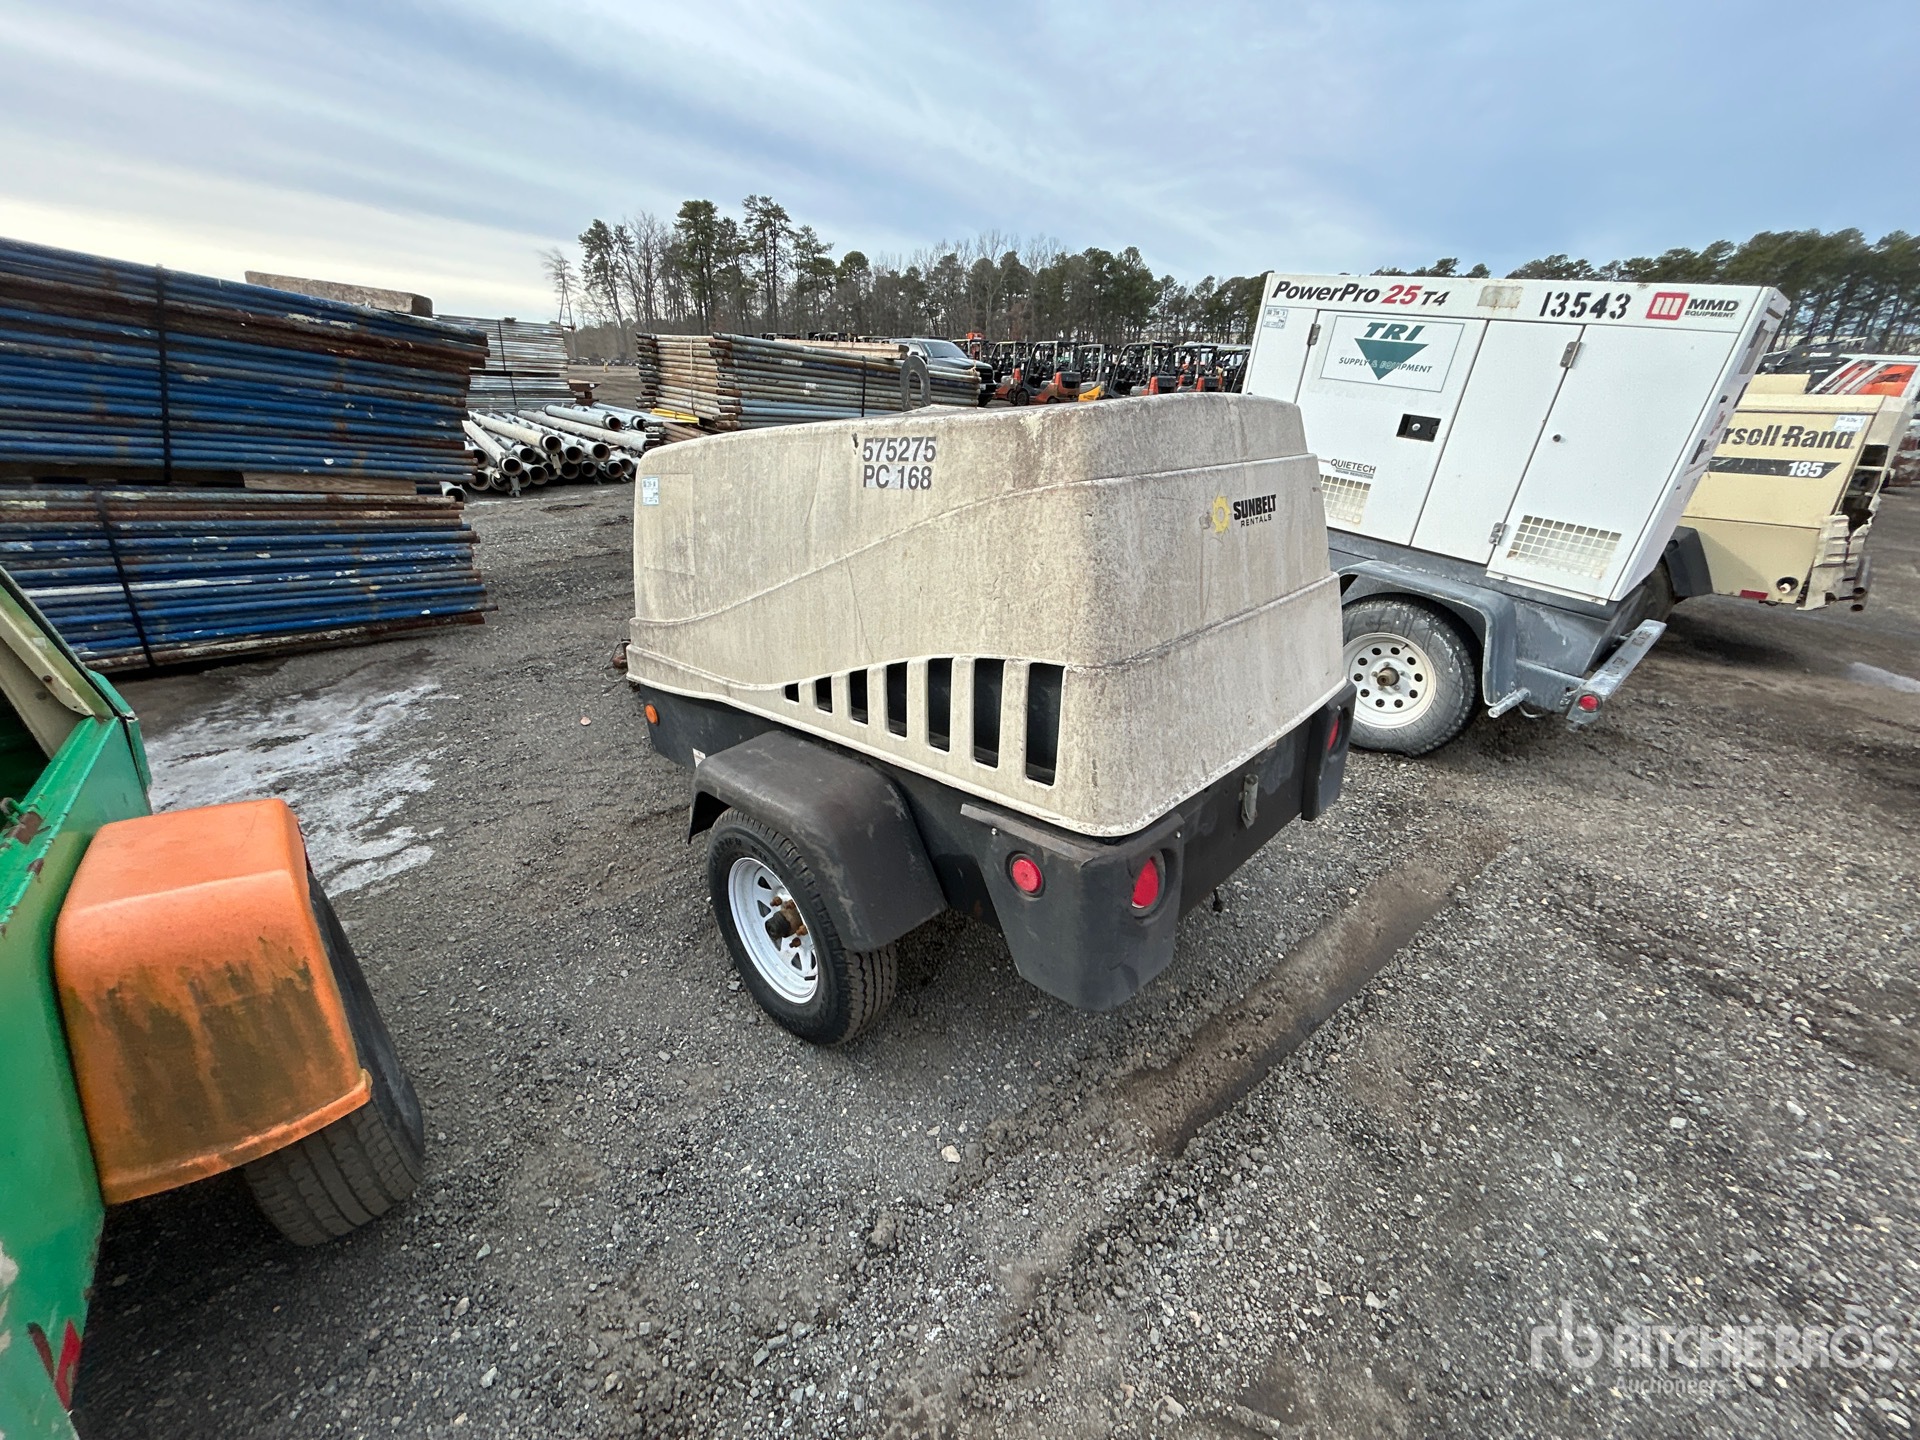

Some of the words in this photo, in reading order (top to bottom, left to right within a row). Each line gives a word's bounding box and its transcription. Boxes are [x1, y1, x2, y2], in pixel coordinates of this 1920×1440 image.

[1272, 281, 1380, 303] PowerPro
[1381, 284, 1422, 305] 25
[1421, 291, 1450, 306] T4
[1539, 291, 1631, 319] 13543
[1684, 310, 1735, 318] EQUIPMENT
[1688, 299, 1739, 312] MMD
[1364, 322, 1426, 341] TRI
[1338, 357, 1370, 367] SUPPLY
[1379, 360, 1433, 374] EQUIPMENT
[862, 436, 937, 462] 575275
[1330, 458, 1376, 474] QUIETECH
[1788, 461, 1825, 477] 185
[863, 464, 890, 489] PC
[897, 465, 932, 490] 168
[1233, 494, 1276, 520] SUNBELT
[1240, 514, 1272, 528] RENTALS
